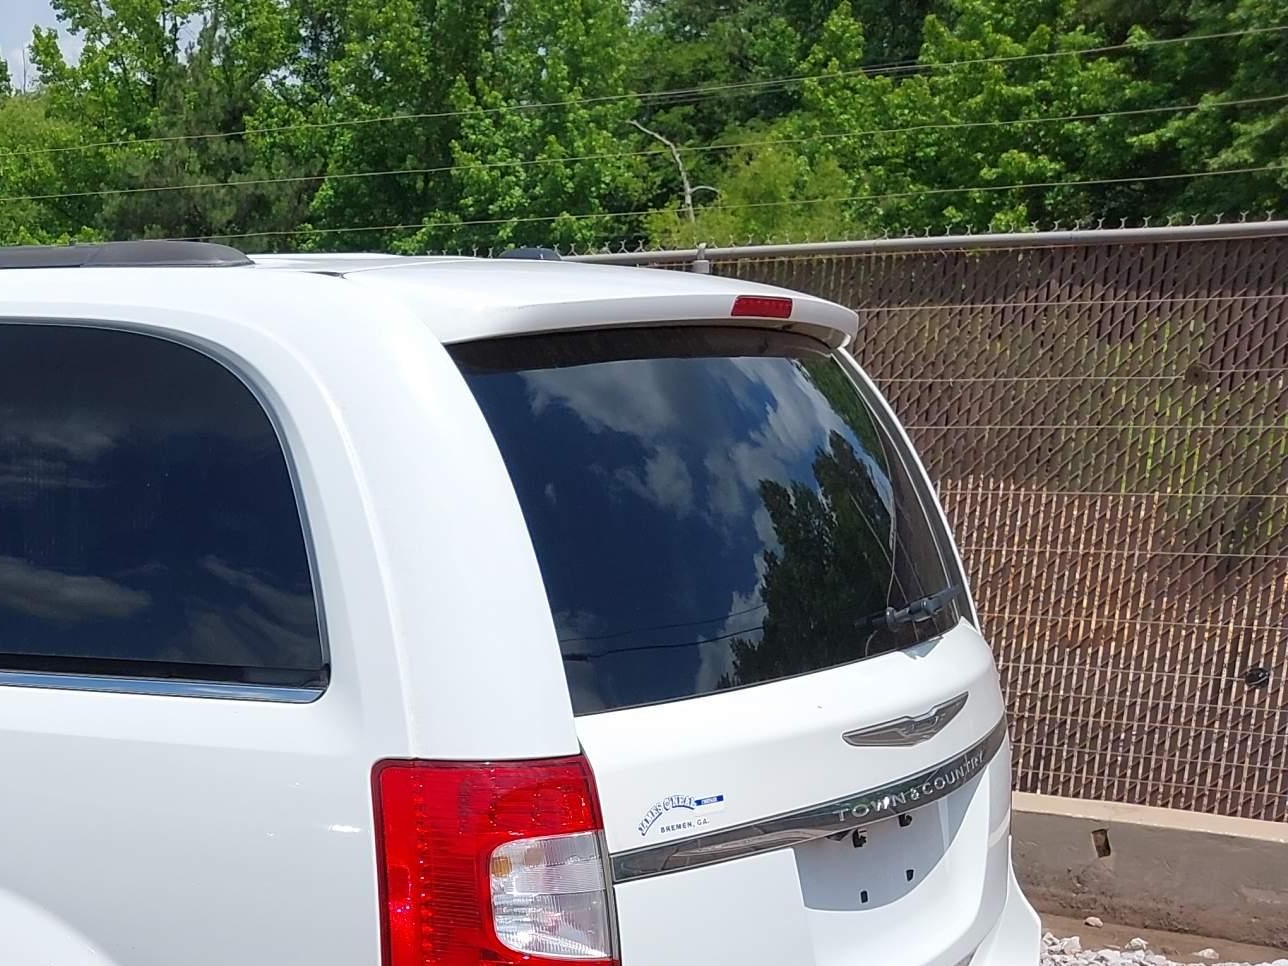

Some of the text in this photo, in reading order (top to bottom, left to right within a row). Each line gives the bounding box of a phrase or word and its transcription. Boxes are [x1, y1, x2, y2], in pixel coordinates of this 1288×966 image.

[832, 750, 985, 822] TOWN & COUNTRY
